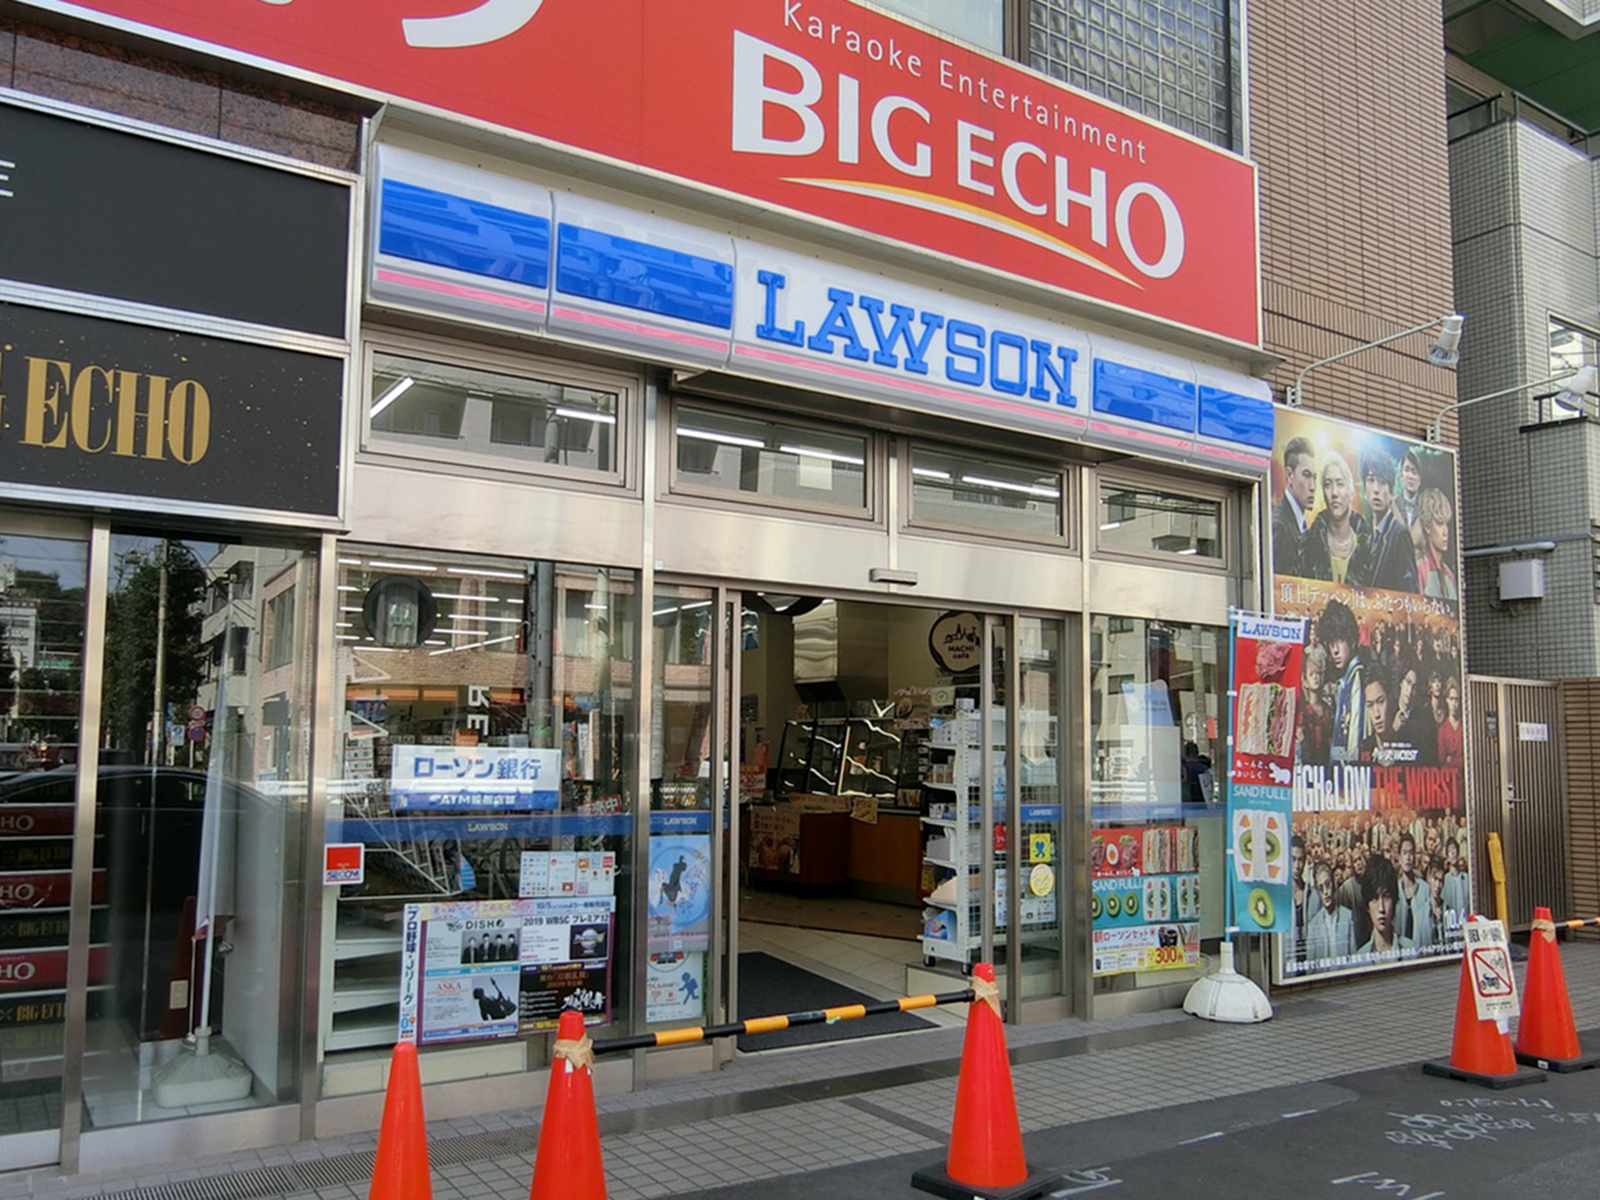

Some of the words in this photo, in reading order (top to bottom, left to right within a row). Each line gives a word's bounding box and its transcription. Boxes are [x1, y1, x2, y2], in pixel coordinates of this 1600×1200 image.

[783, 0, 922, 77] Karaoke
[939, 58, 1147, 164] Entertainment
[732, 29, 932, 178] BIG
[957, 119, 1186, 279] ECHO
[756, 269, 1078, 408] LAWSON
[18, 355, 211, 466] ECHO
[1241, 621, 1301, 639] LAWSON
[413, 757, 542, 780] ローソン銀行
[1233, 785, 1259, 797] SAND
[1373, 766, 1402, 810] THE
[1405, 766, 1460, 810] WORST
[468, 822, 509, 832] LAWSON
[1092, 879, 1118, 892] SAND
[523, 918, 544, 927] 2019
[545, 916, 569, 925] WBSC
